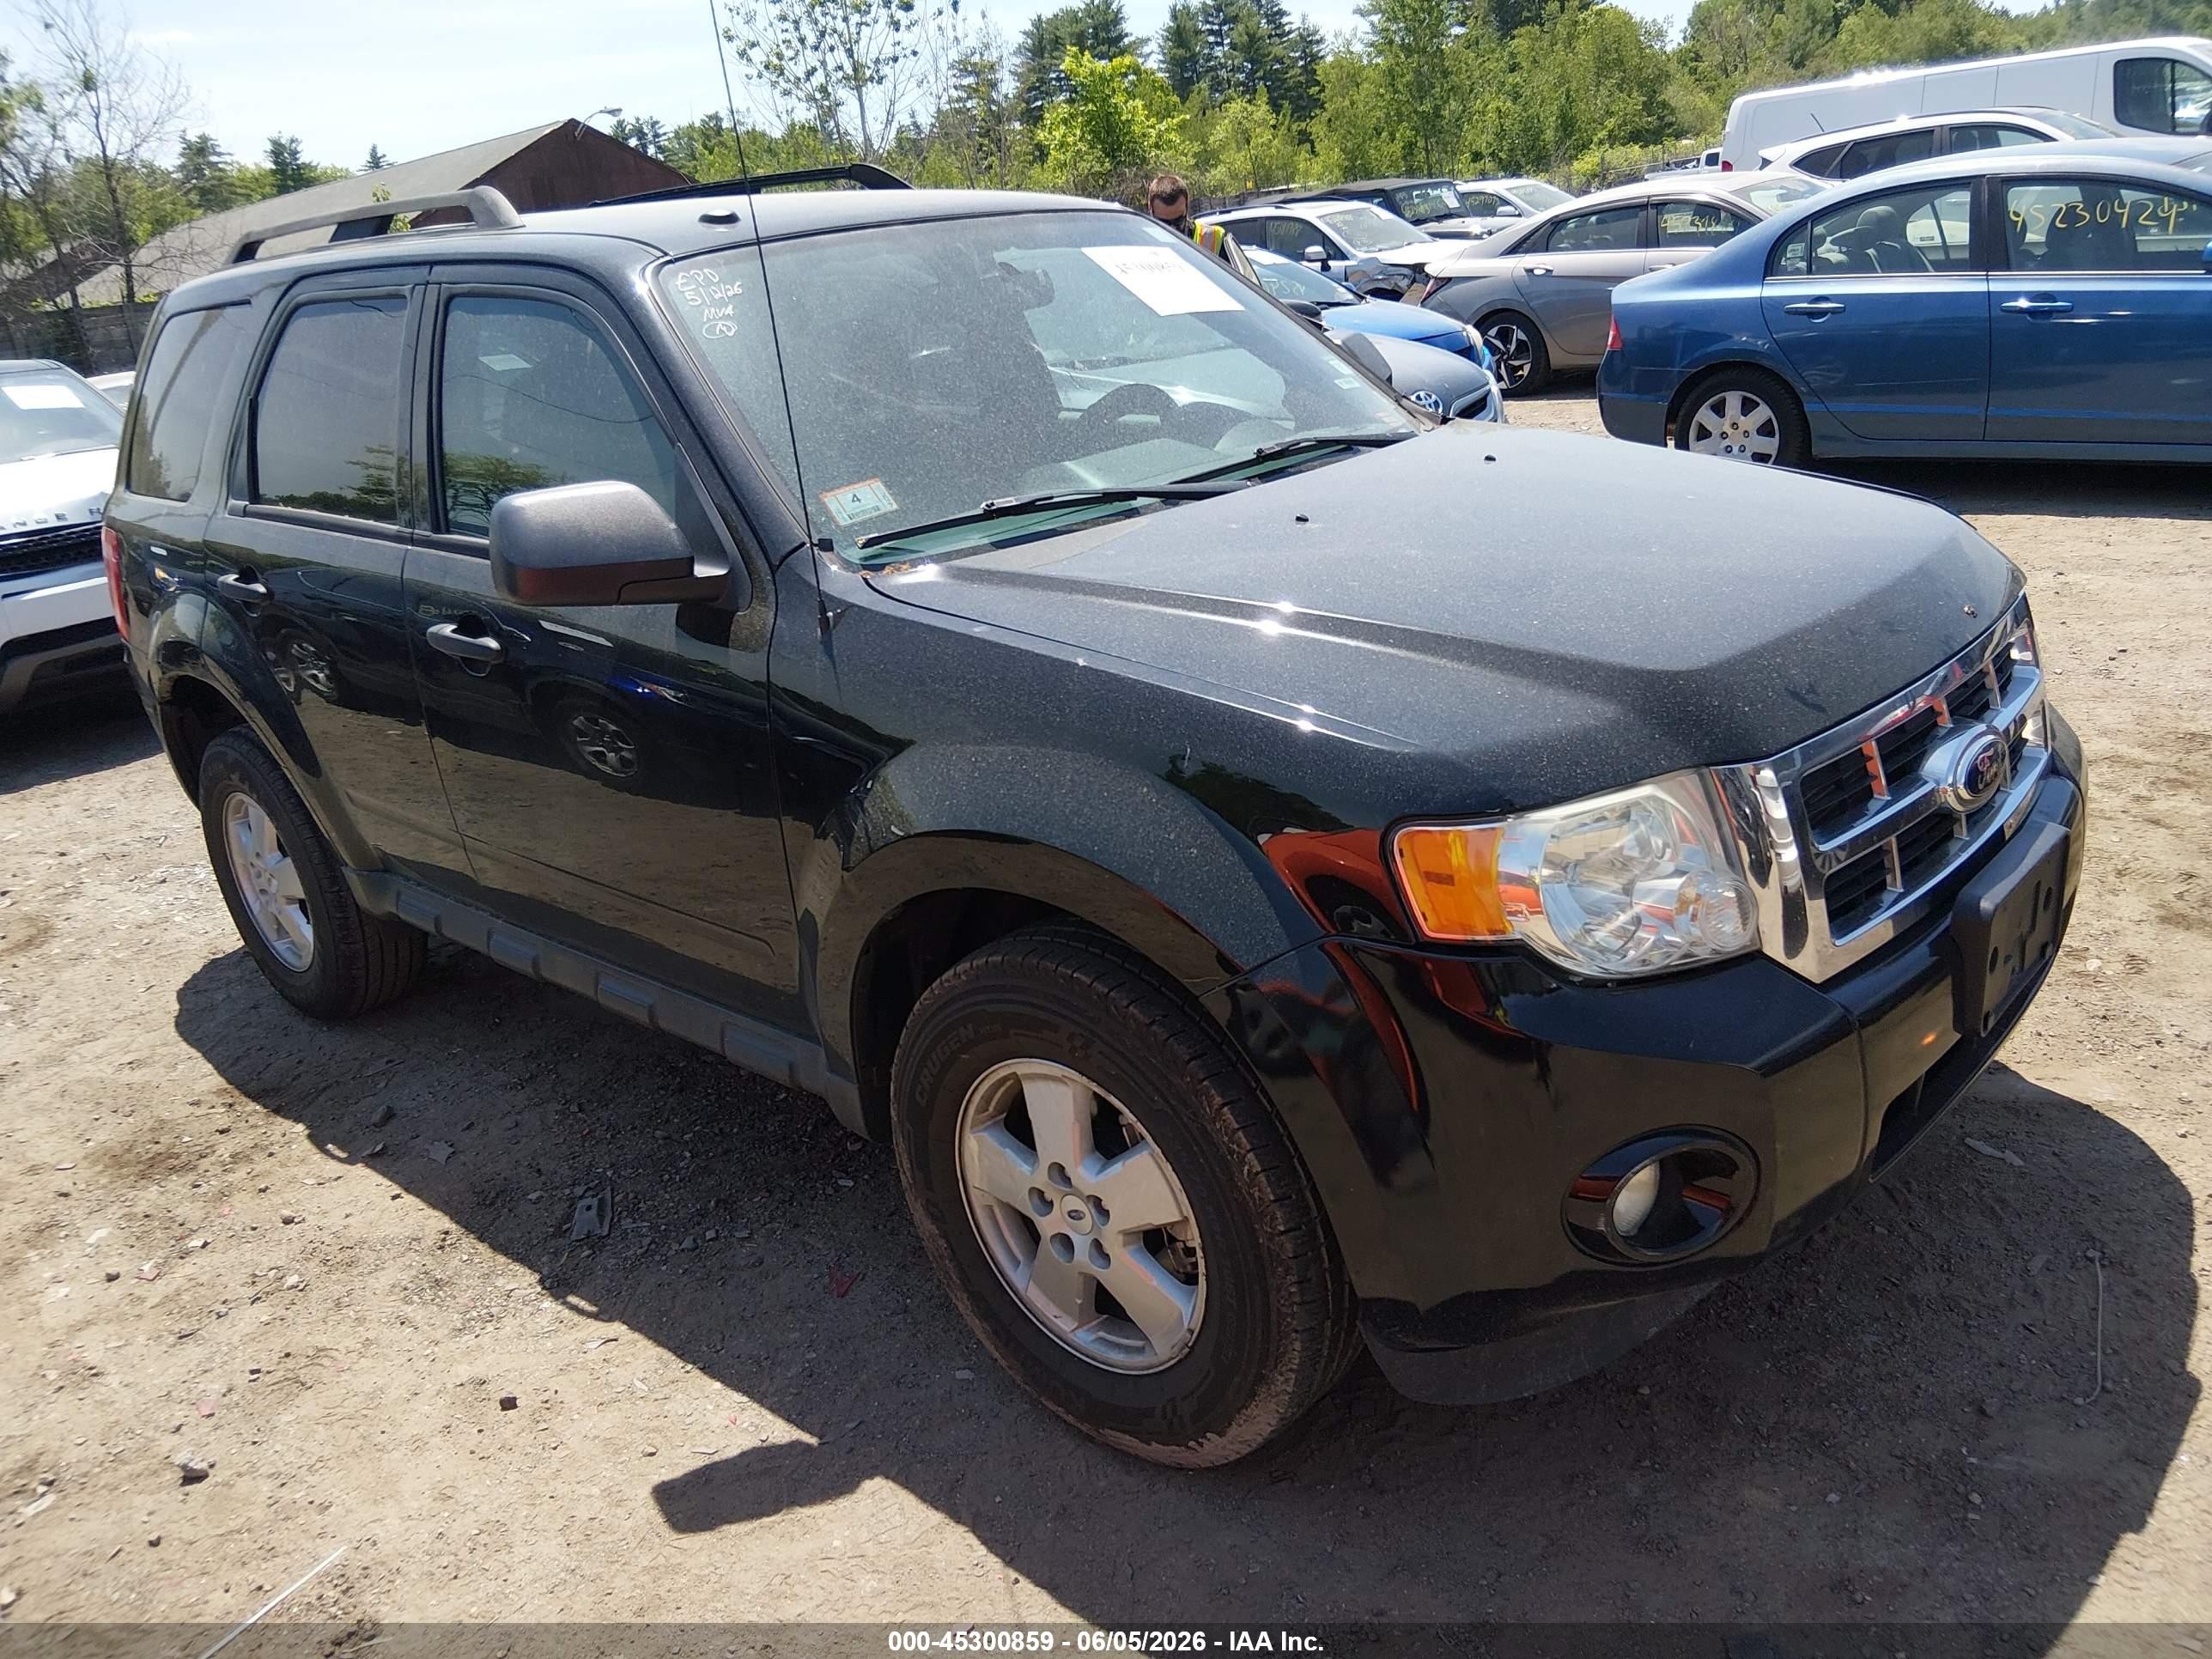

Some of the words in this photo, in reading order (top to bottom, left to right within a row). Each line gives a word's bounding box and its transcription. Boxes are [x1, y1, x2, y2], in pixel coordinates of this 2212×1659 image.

[675, 269, 720, 292] EPD
[684, 281, 743, 307] 5/12/26
[702, 303, 735, 322] MVA
[851, 493, 862, 503] 4
[915, 1023, 976, 1107] CRUGEN
